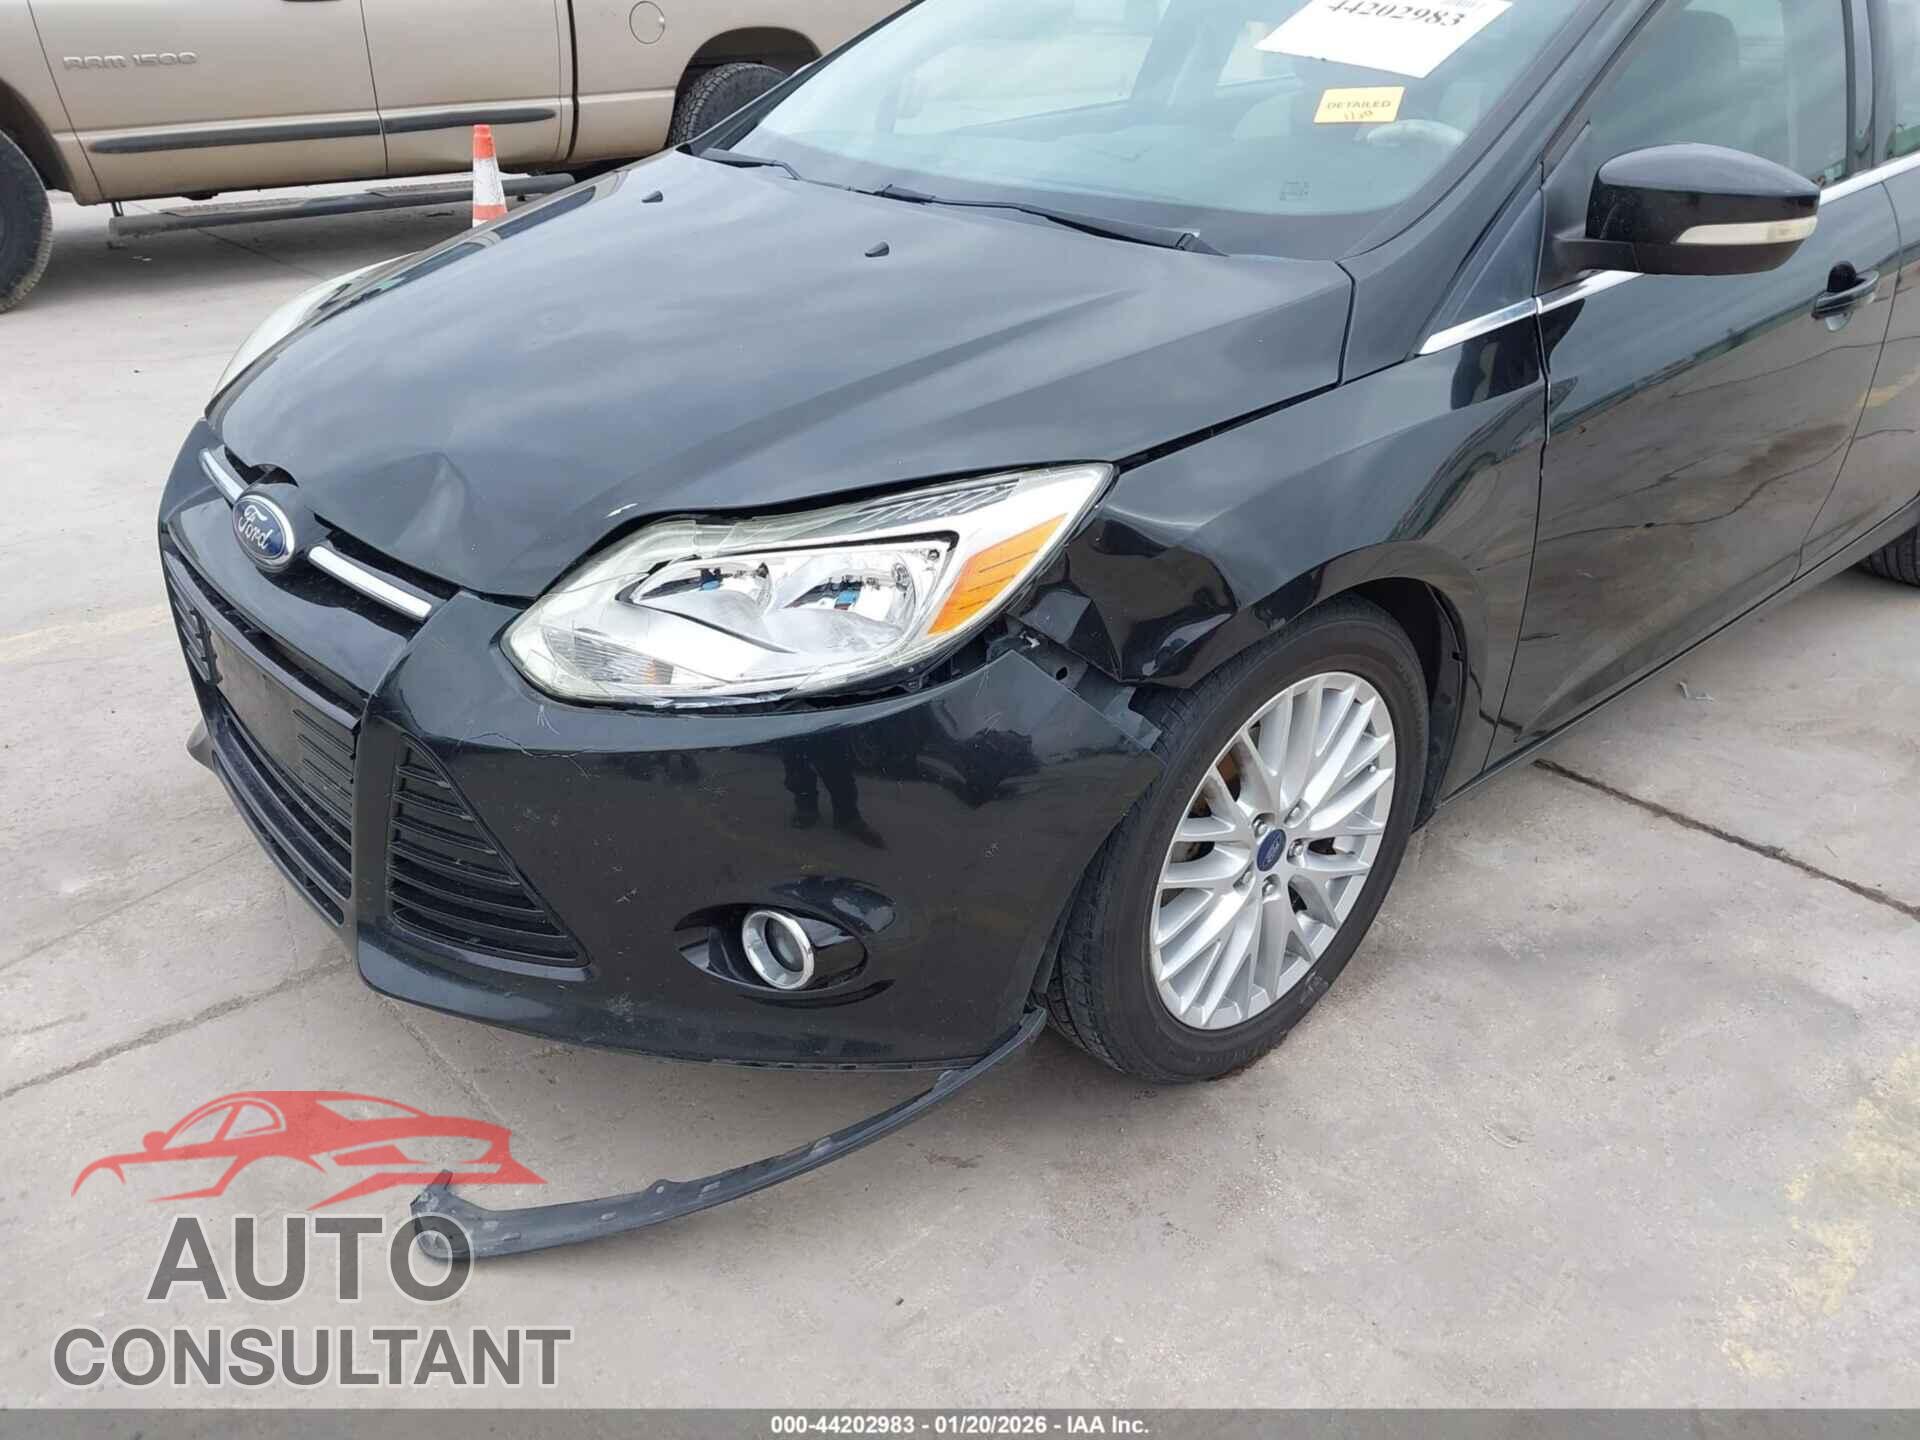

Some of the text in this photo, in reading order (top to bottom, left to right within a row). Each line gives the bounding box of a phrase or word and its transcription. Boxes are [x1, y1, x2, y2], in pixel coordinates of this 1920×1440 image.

[1327, 0, 1466, 27] 44202983
[63, 52, 198, 69] RAM 1500
[1326, 100, 1392, 109] DETAILED
[239, 504, 274, 550] Ford
